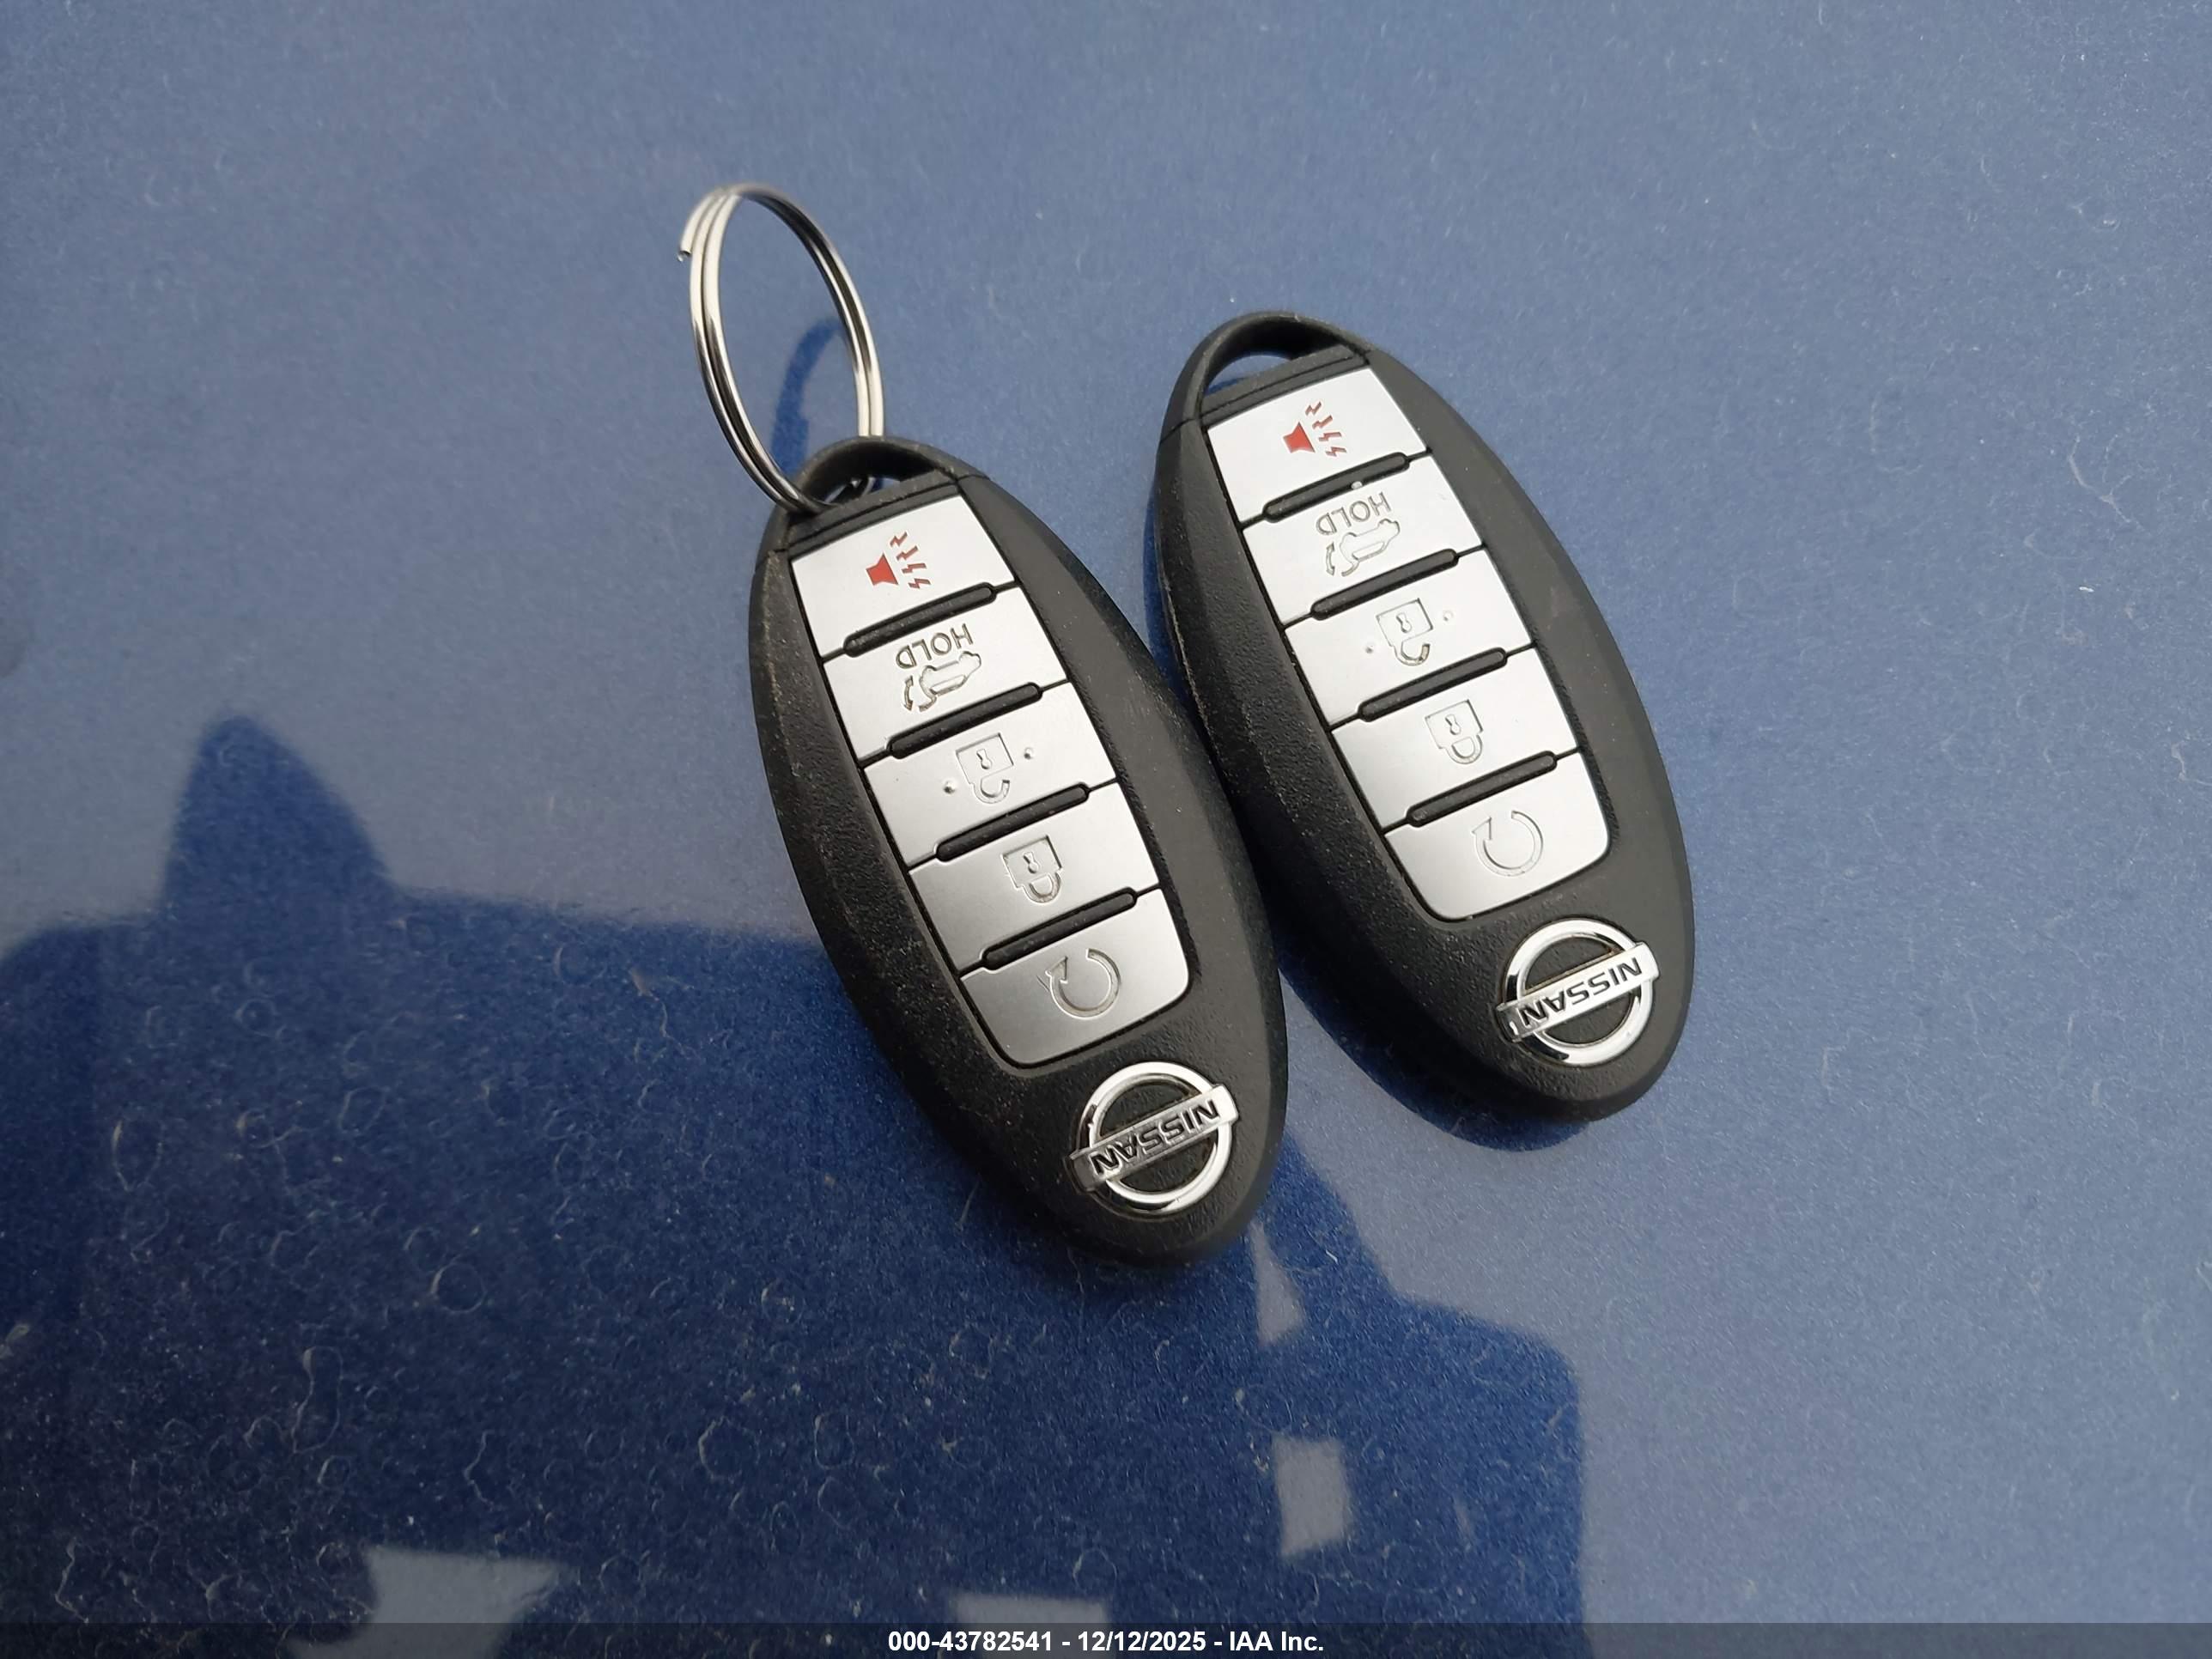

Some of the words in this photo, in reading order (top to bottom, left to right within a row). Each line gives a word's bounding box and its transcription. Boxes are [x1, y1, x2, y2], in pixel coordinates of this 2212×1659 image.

[1316, 491, 1392, 536] HOLD
[896, 623, 974, 670] HOLD
[1518, 957, 1643, 1026] NISSAN
[1089, 1098, 1220, 1176] NISSAN
